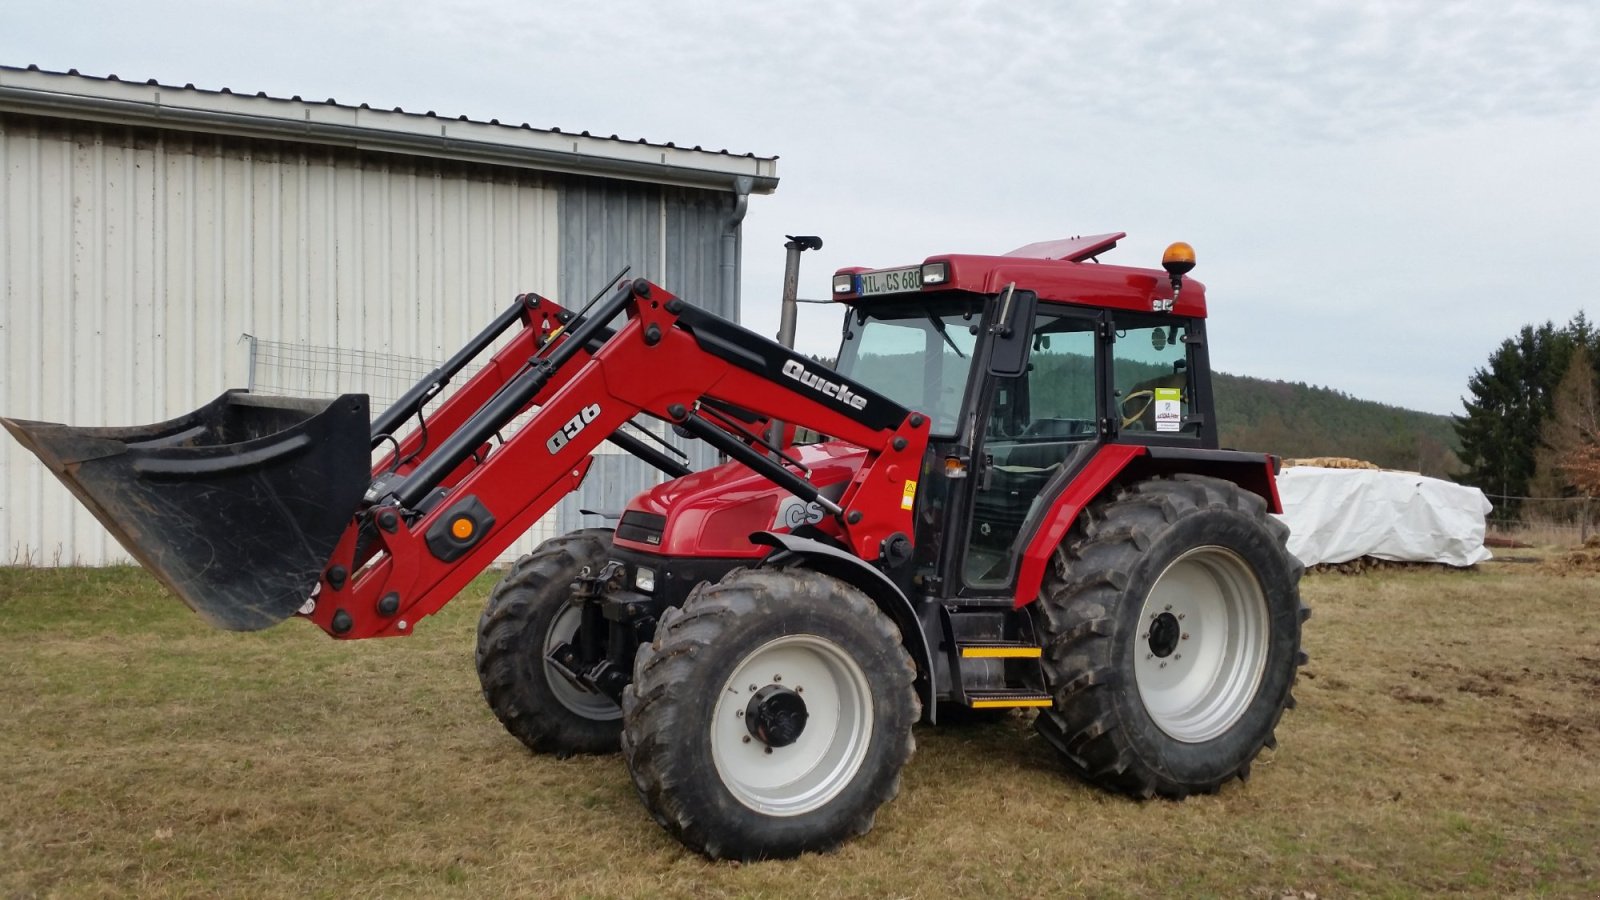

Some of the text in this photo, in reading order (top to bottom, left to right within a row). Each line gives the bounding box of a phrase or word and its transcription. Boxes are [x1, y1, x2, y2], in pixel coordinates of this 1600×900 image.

[862, 270, 921, 293] MIL CS 680
[782, 359, 867, 410] Quicke
[785, 501, 825, 529] CS
